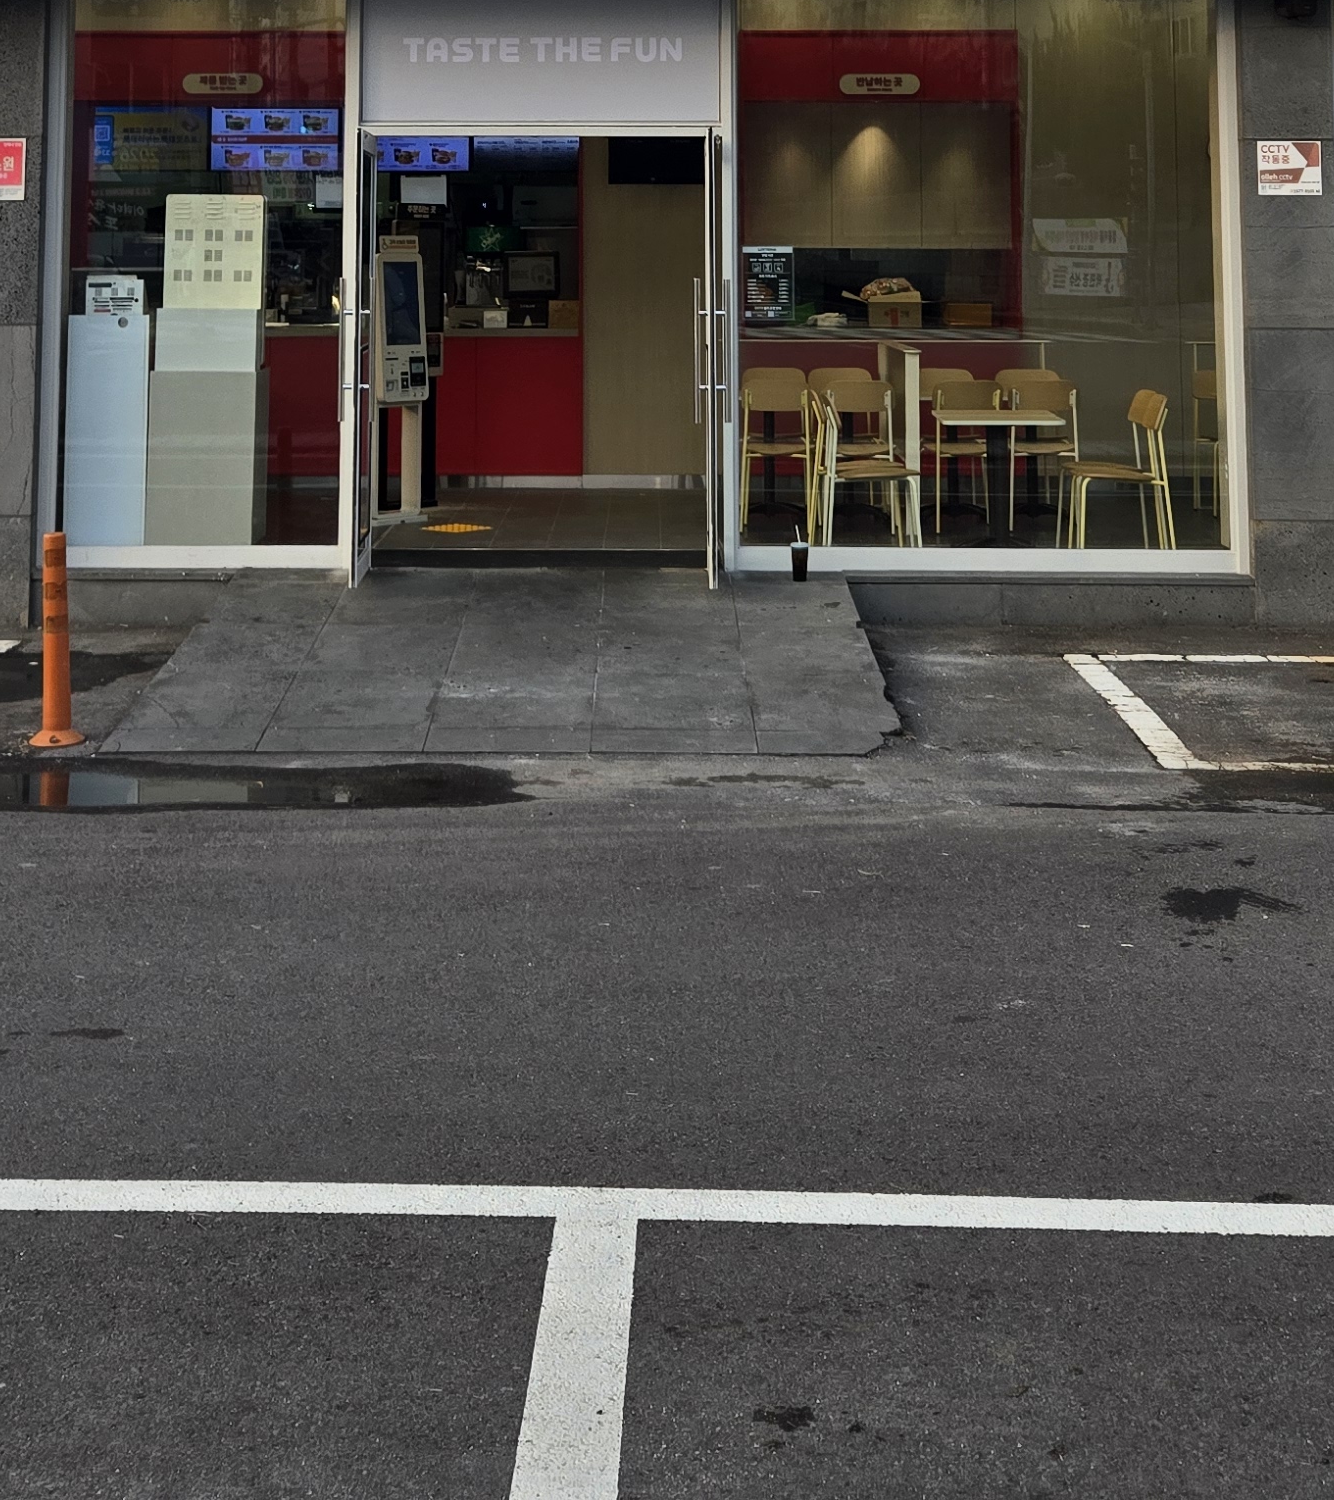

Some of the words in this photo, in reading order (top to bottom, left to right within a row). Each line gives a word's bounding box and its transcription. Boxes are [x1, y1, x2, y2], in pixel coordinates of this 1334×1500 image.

[403, 37, 520, 63] TASTE
[530, 37, 602, 63] THE
[610, 37, 683, 63] FUN
[893, 76, 903, 87] 곳
[1261, 144, 1290, 154] CCTV
[1260, 173, 1278, 181] olleh
